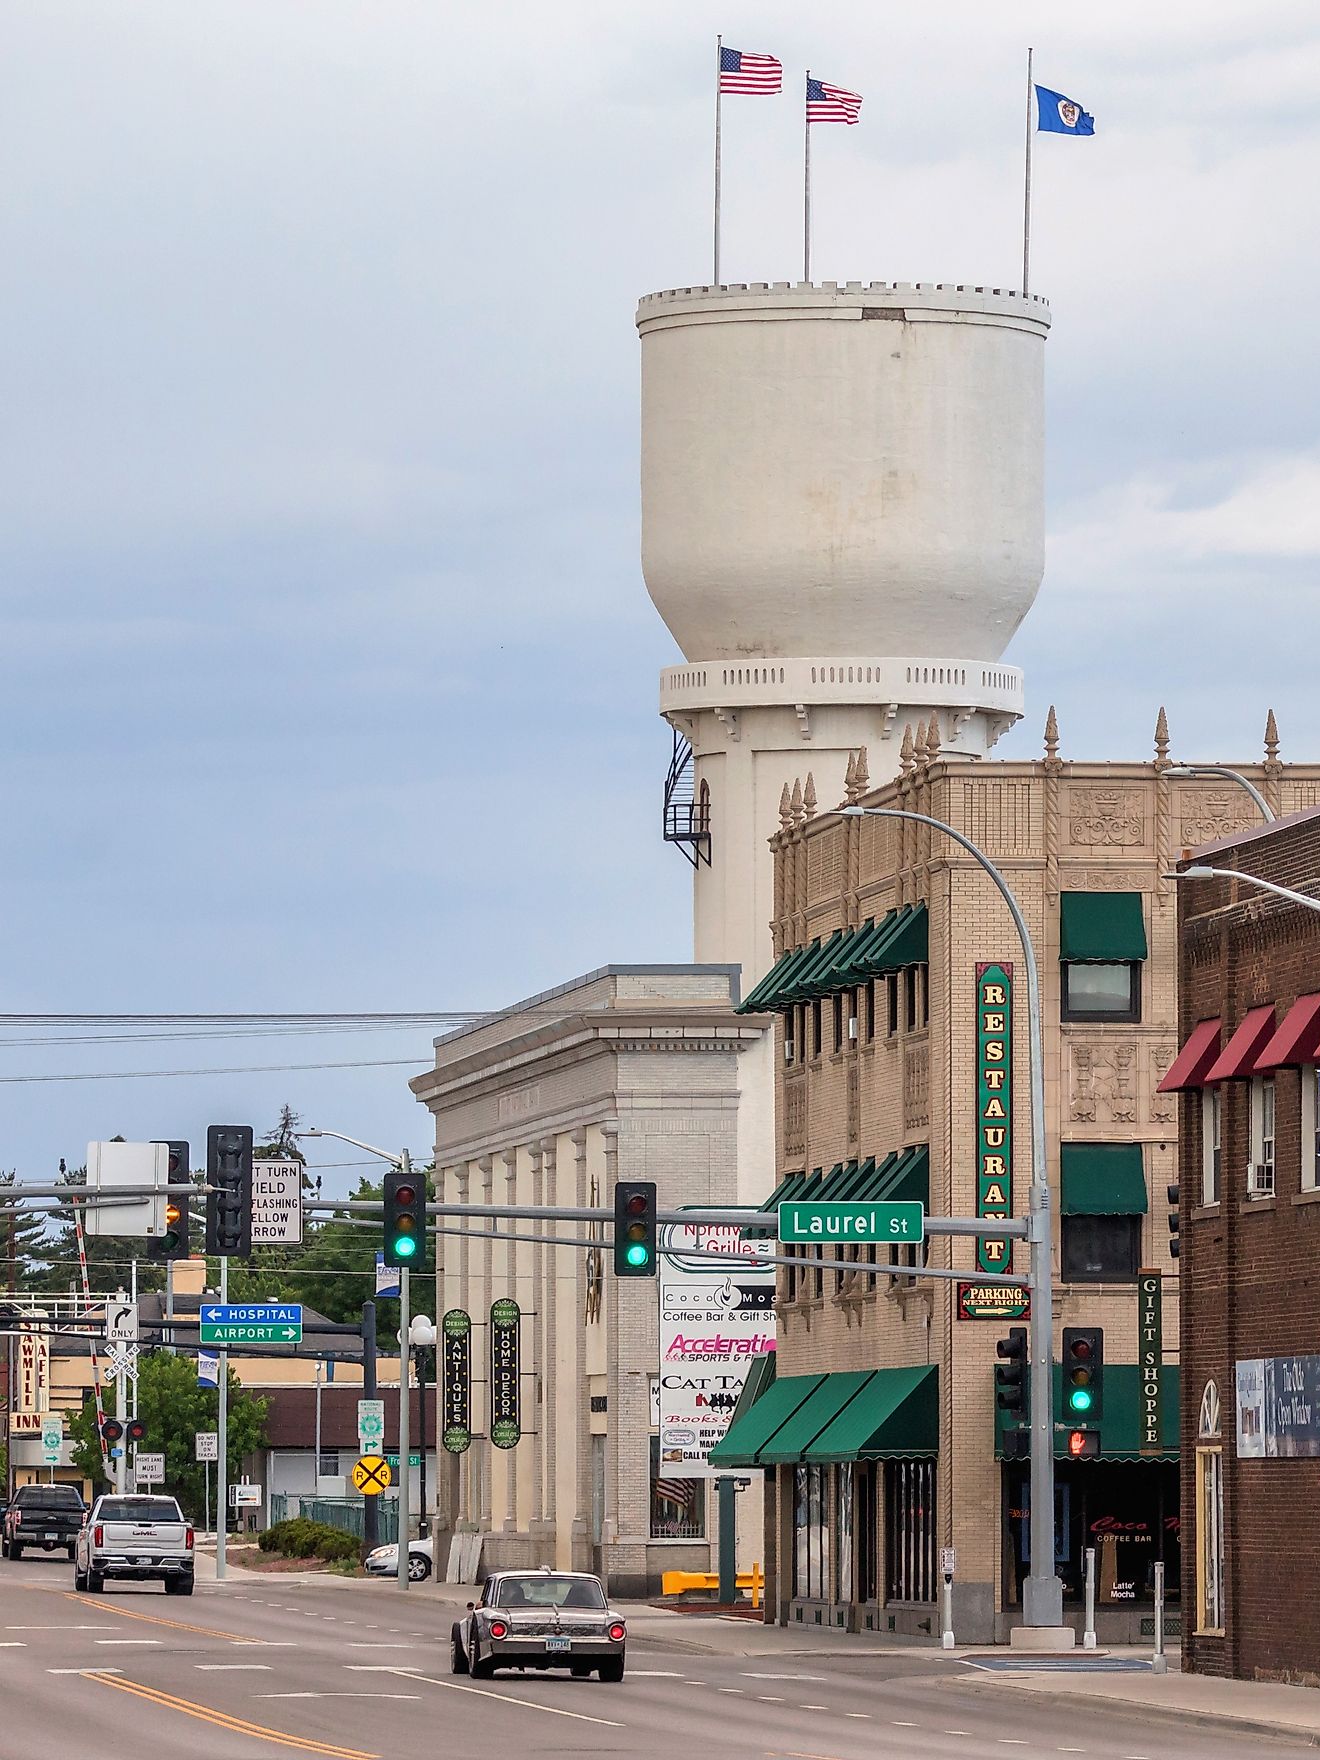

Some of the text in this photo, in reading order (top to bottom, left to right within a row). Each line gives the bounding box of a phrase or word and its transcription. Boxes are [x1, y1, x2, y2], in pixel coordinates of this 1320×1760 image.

[267, 1167, 296, 1177] TURN
[252, 1213, 288, 1222] ELLOW
[794, 1211, 908, 1234] Laurel St
[251, 1227, 286, 1236] RROW
[706, 1239, 752, 1253] Grille
[969, 1288, 1023, 1299] PARKING
[229, 1309, 295, 1319] HOSPITAL
[663, 1311, 703, 1322] Coffee
[706, 1312, 724, 1321] Bar
[728, 1312, 737, 1321] &
[740, 1312, 760, 1321] Gift
[111, 1330, 134, 1338] ONLY
[214, 1328, 273, 1338] AIRPORT
[687, 1353, 730, 1362] SPORTS
[733, 1353, 741, 1362] &
[1143, 1279, 1159, 1443] GIFT SHOPPE
[501, 1330, 511, 1416] HOME DECOR
[452, 1341, 462, 1423] ANTIQUES
[661, 1375, 711, 1389] CAT
[16, 1415, 41, 1428] INN
[664, 1413, 719, 1423] Books
[699, 1429, 716, 1438] HELP
[683, 1451, 700, 1460] CALL
[356, 1470, 388, 1480] R R
[1110, 1590, 1136, 1599] Mocha
